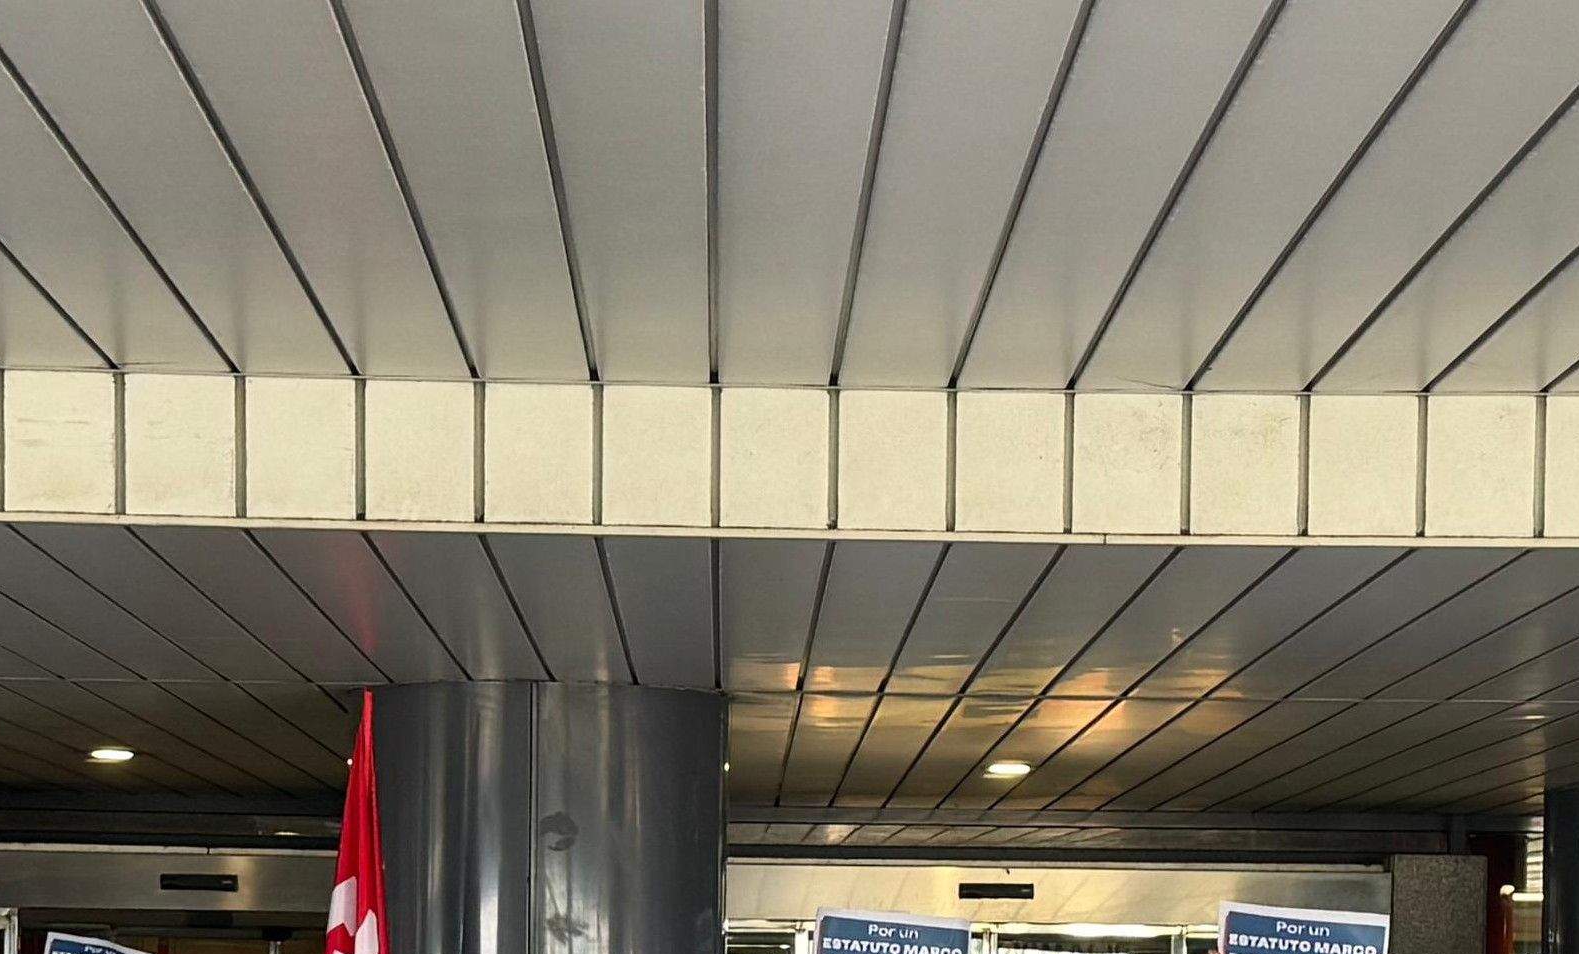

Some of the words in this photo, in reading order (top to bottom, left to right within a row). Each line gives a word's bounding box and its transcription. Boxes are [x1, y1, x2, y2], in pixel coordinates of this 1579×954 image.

[868, 924, 896, 936] Por
[899, 929, 919, 939] un
[1276, 921, 1305, 934] Por
[1308, 925, 1329, 936] un
[822, 938, 900, 954] ESTATUTO
[1229, 934, 1312, 952] ESTATUTO
